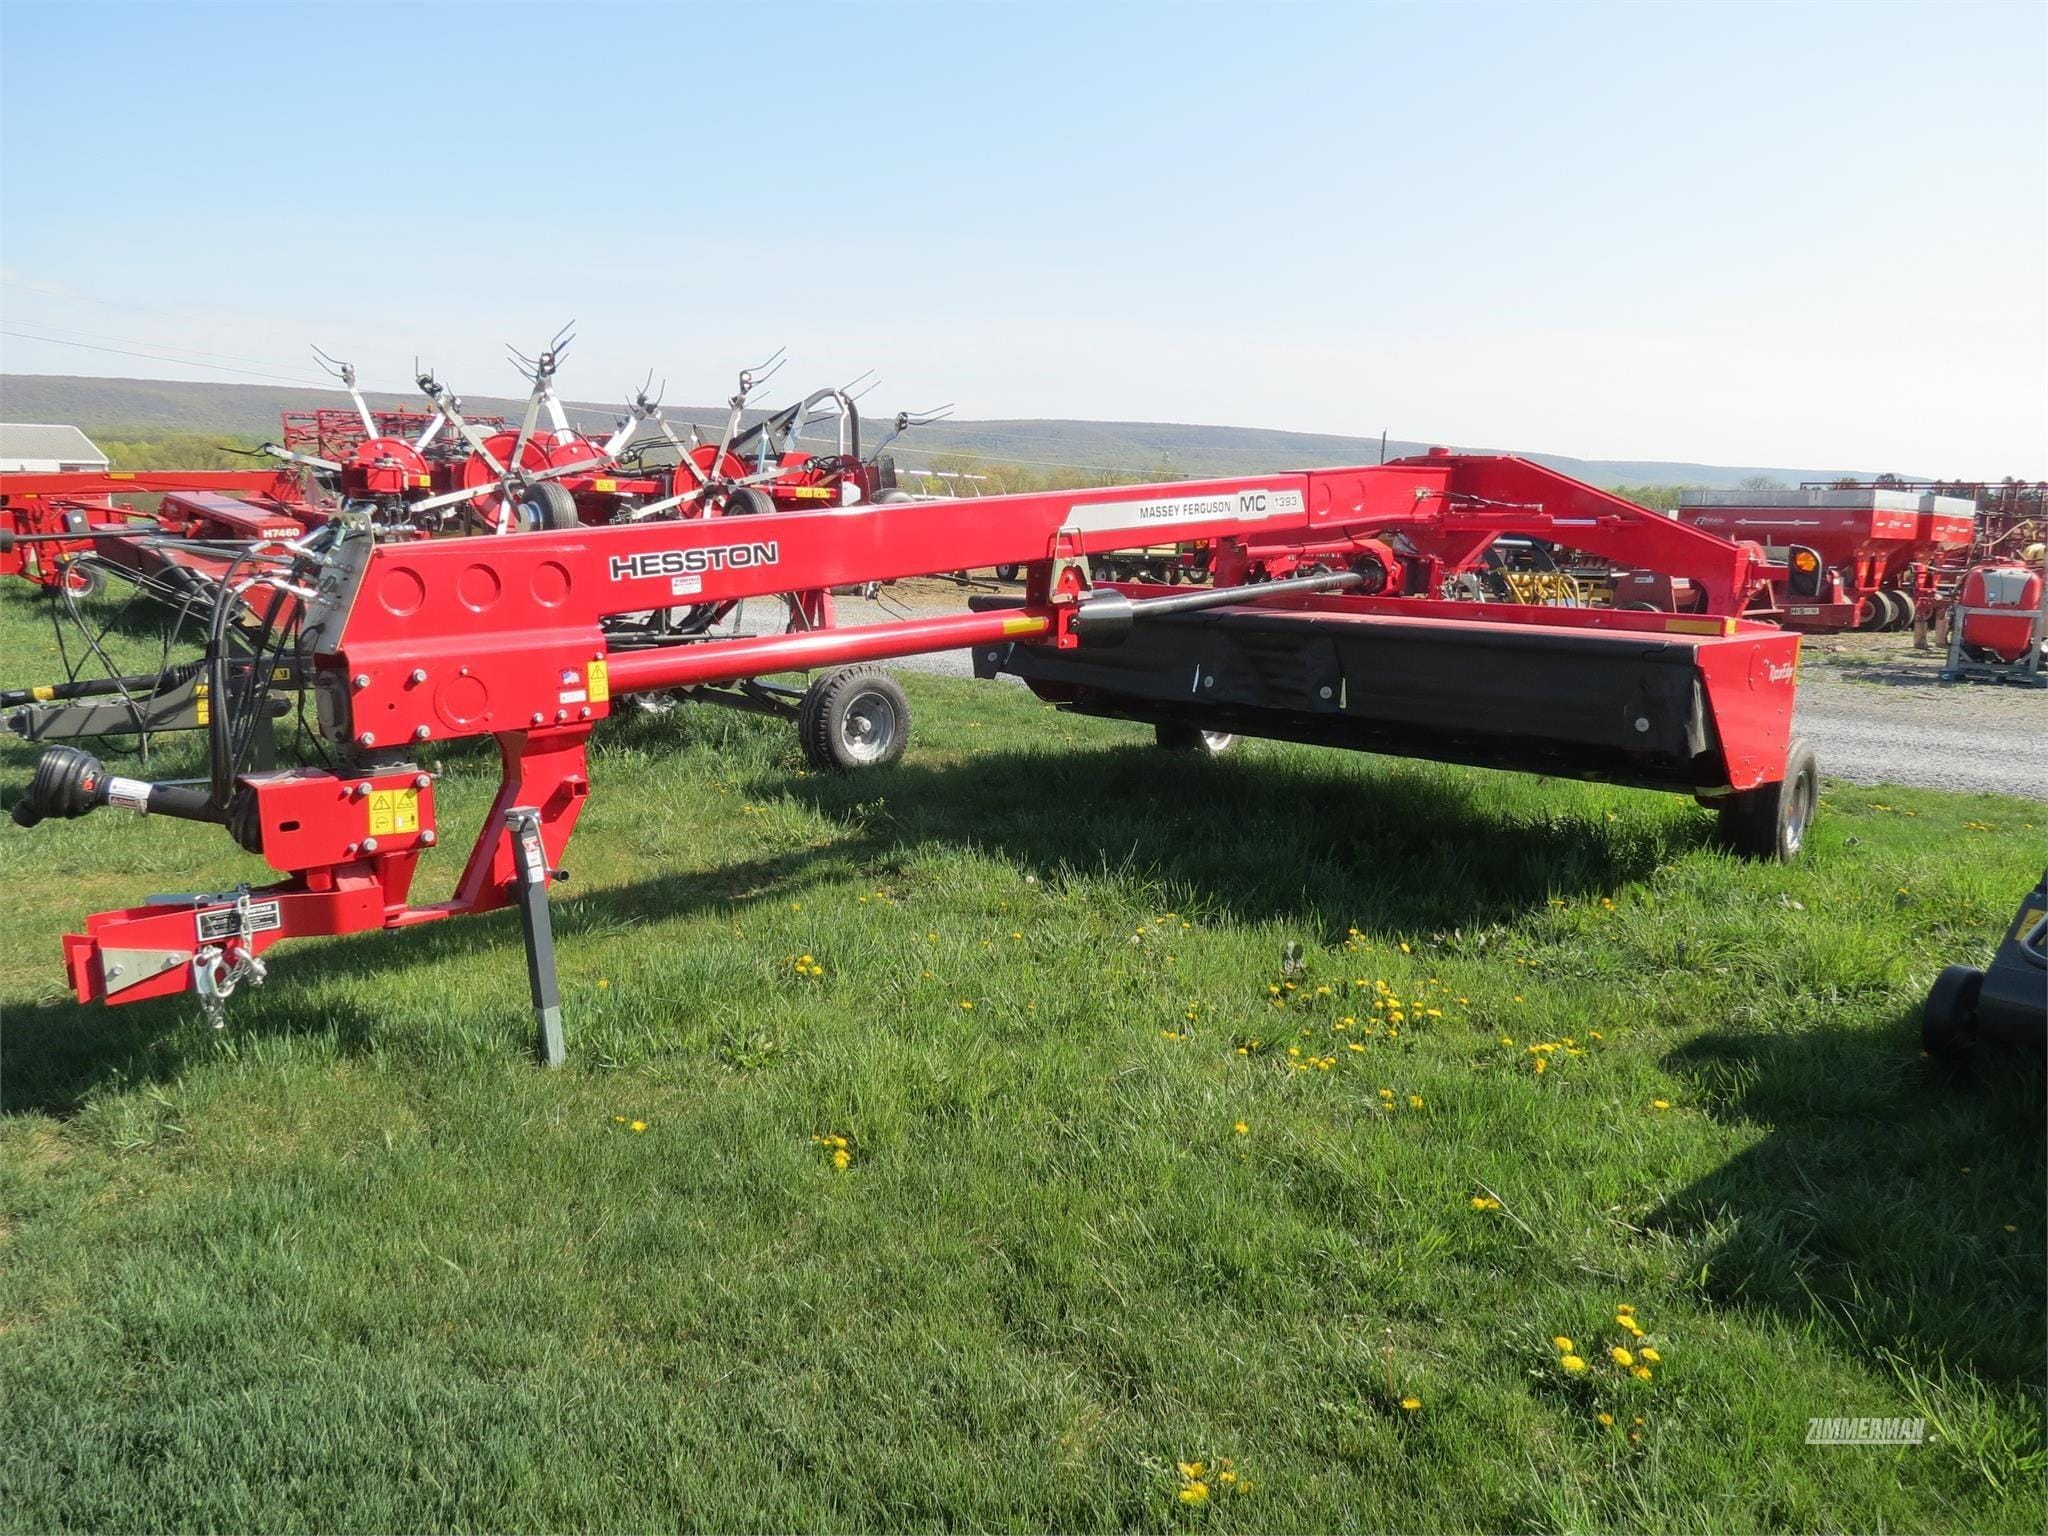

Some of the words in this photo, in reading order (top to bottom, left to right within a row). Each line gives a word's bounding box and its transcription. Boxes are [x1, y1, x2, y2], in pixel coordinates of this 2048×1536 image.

[1139, 504, 1180, 519] MASSEY
[1182, 501, 1232, 515] FERGUSON
[1239, 494, 1267, 513] MC
[1274, 496, 1298, 508] 1393
[262, 527, 300, 539] H7460
[609, 541, 779, 582] HESSTON
